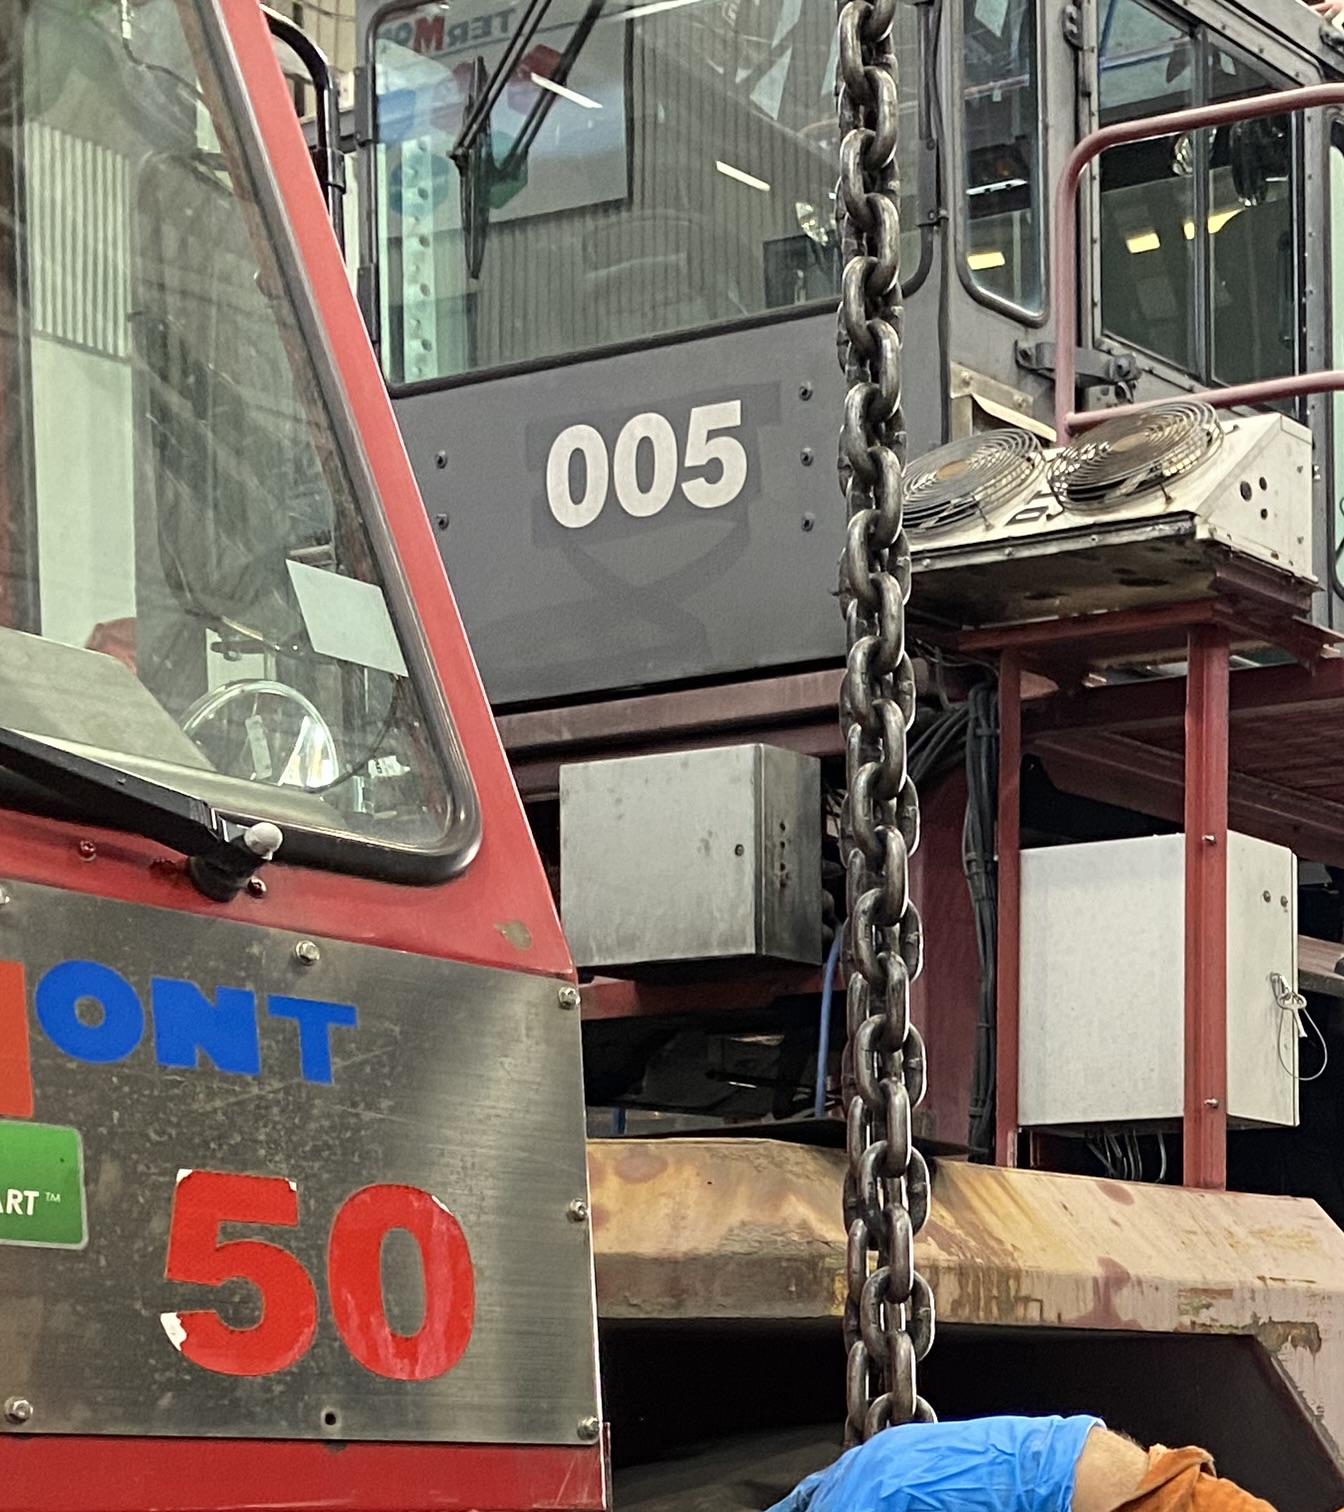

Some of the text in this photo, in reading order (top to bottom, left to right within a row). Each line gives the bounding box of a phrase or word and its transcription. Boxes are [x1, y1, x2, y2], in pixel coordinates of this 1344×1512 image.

[546, 399, 748, 529] 005
[0, 959, 357, 1118] ONT
[0, 1188, 39, 1215] RT
[159, 1167, 475, 1381] 50
